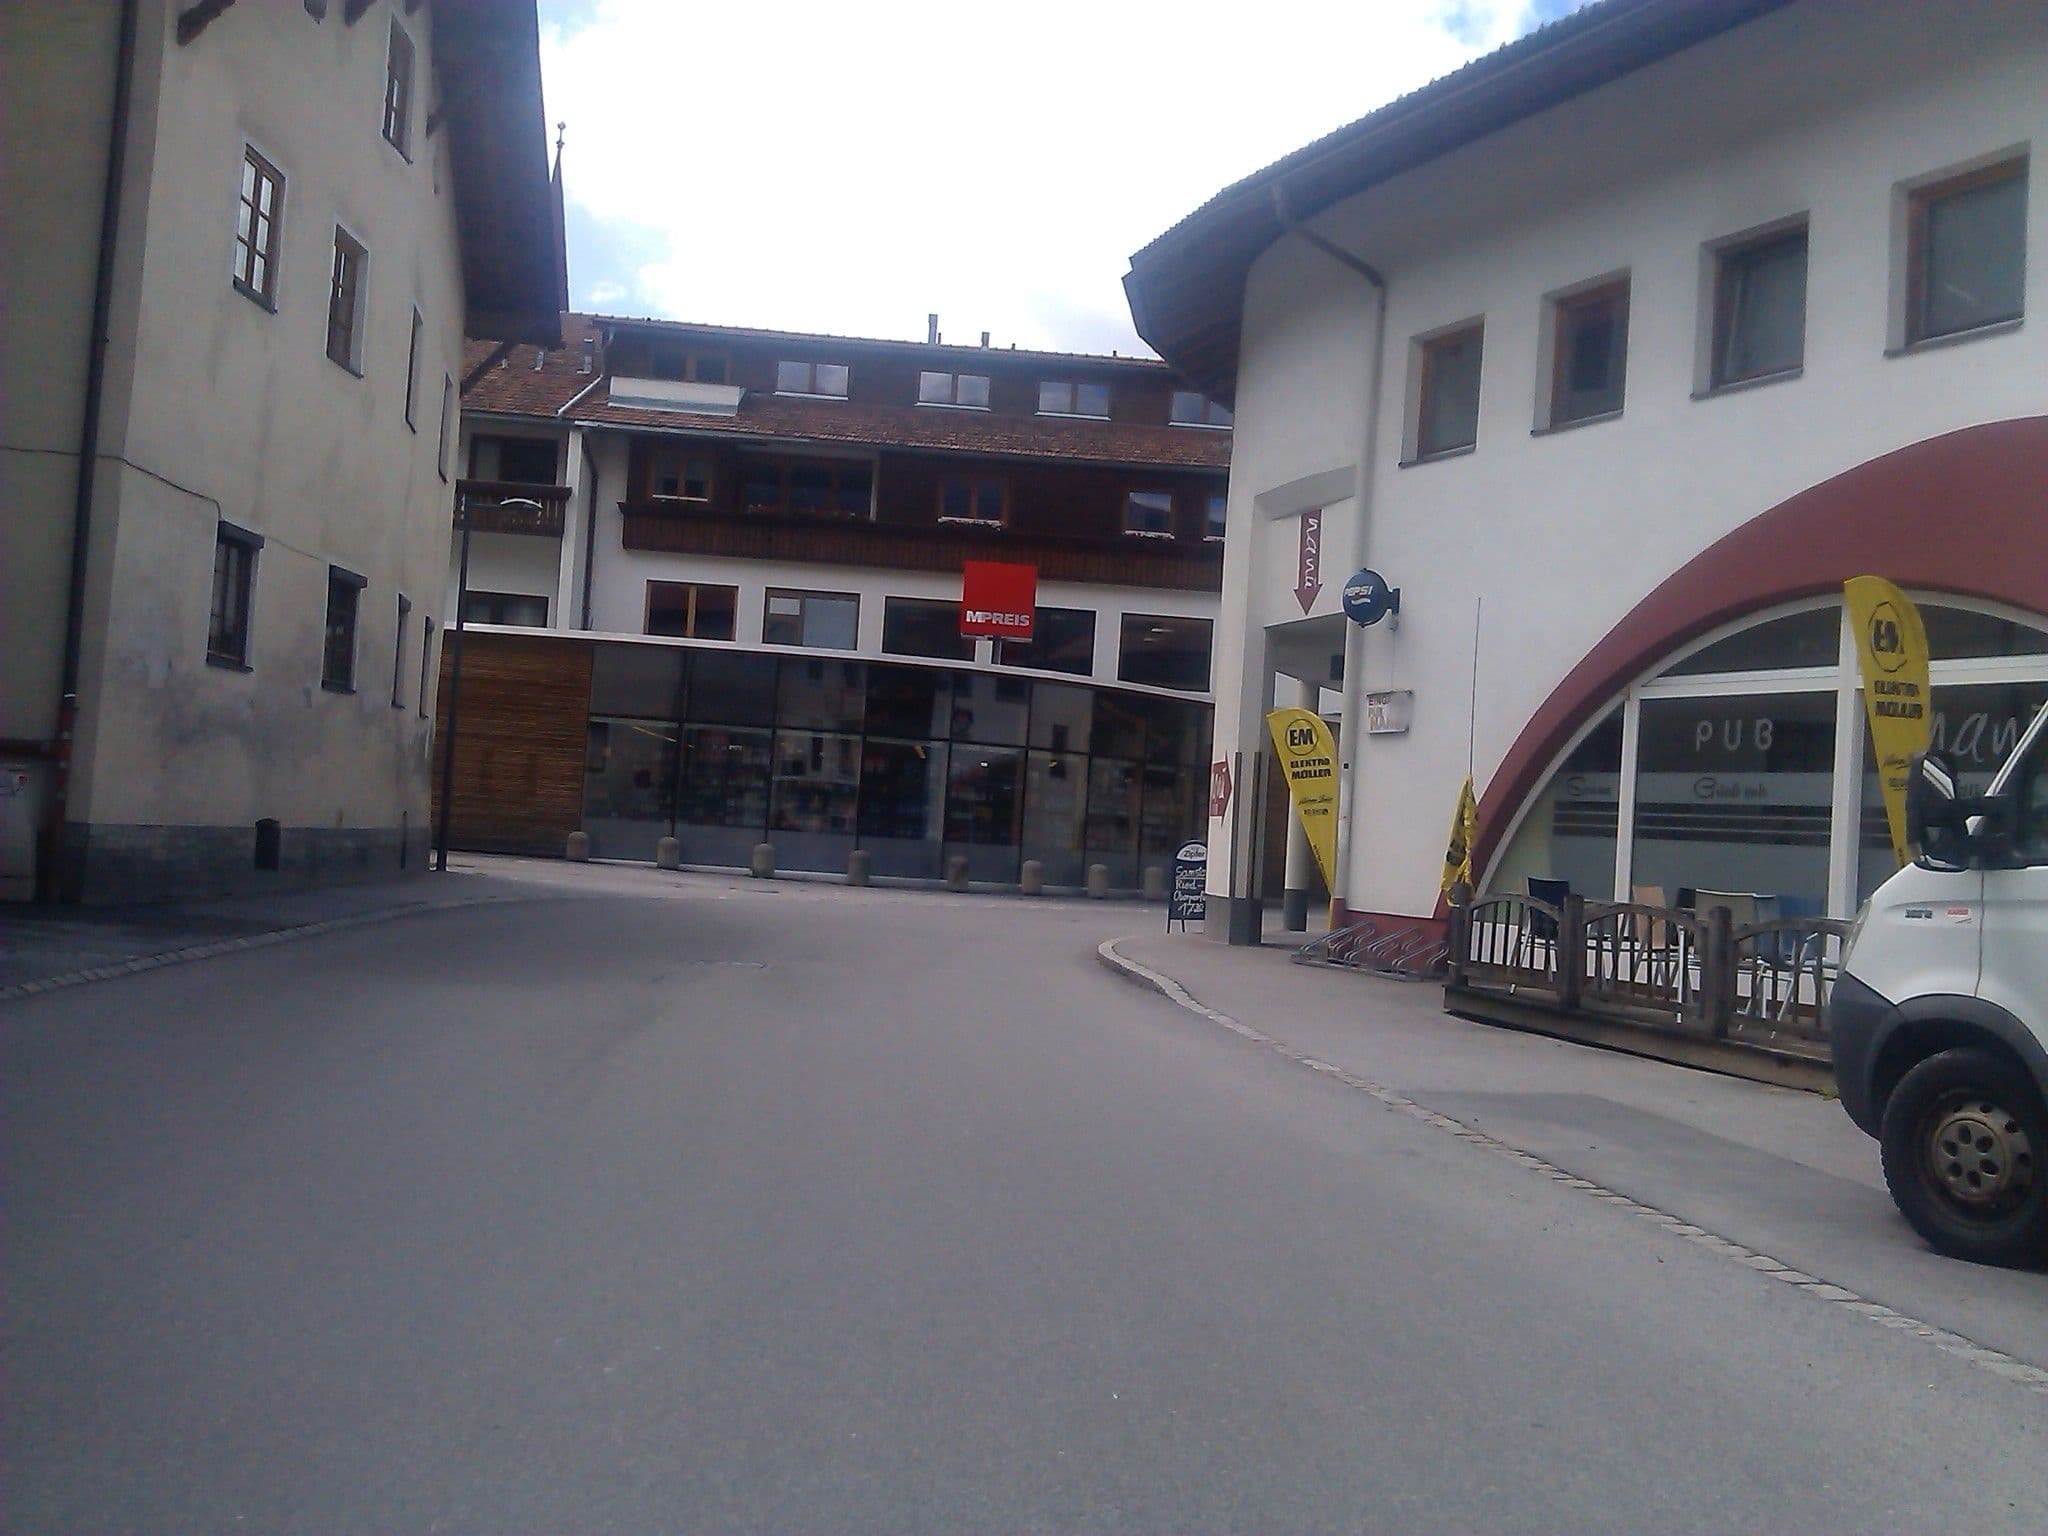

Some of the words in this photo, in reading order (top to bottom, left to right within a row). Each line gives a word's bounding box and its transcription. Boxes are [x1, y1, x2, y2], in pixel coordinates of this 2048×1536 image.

[1344, 585, 1373, 597] PEPSI
[965, 610, 1030, 627] MPREIS
[1289, 729, 1314, 747] EM
[1695, 718, 1774, 751] PUB
[1290, 758, 1331, 769] ELEKTRO
